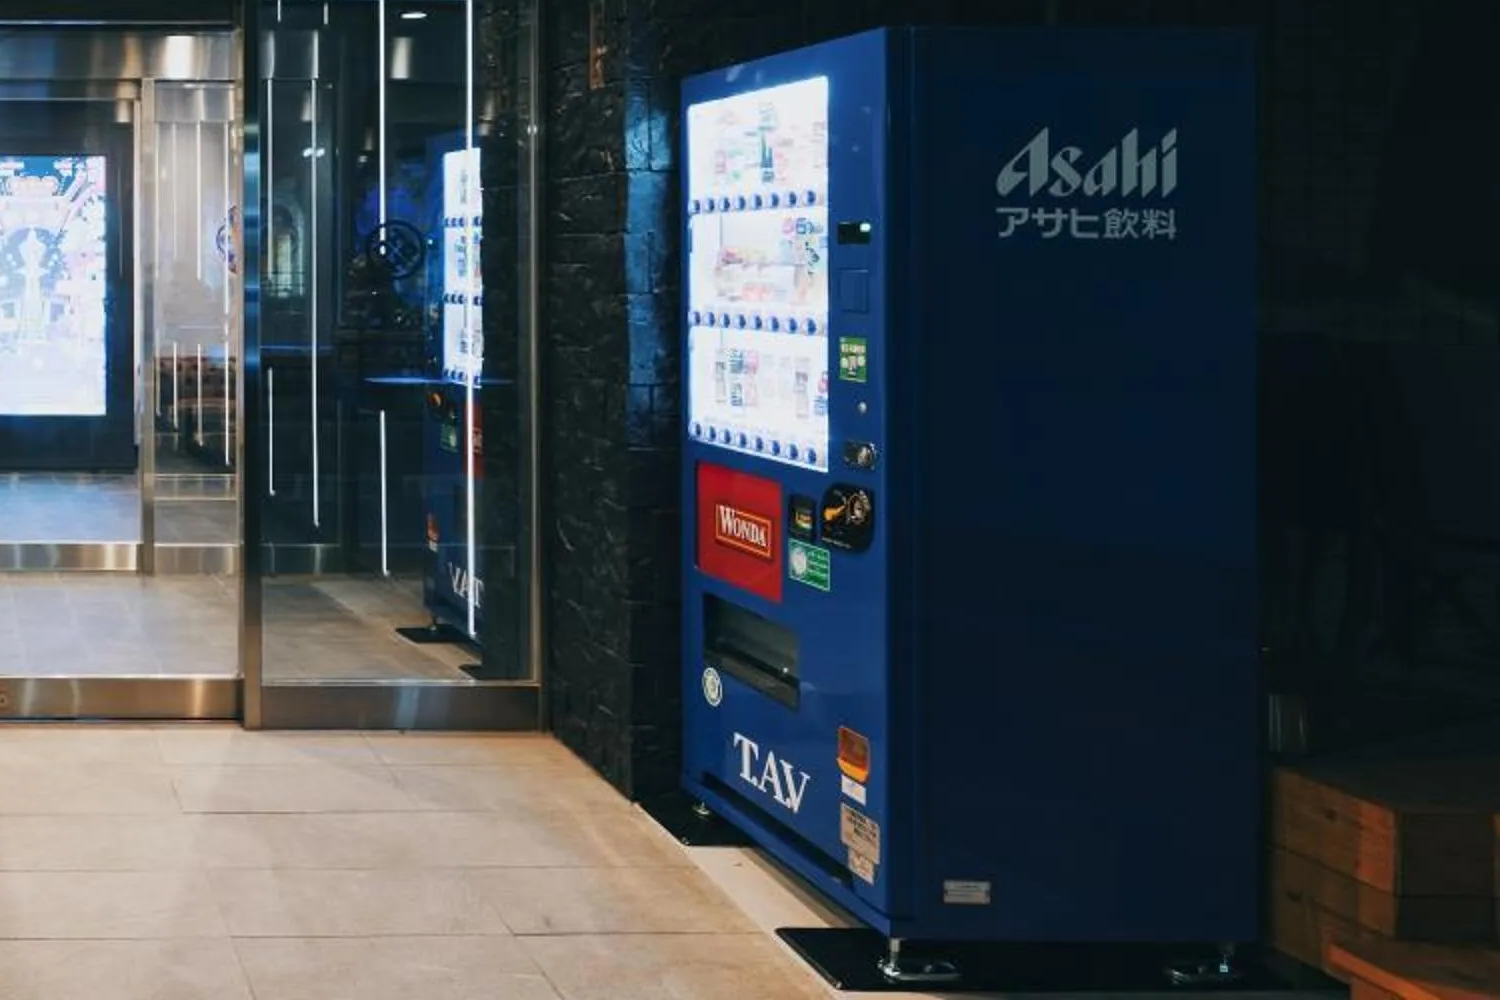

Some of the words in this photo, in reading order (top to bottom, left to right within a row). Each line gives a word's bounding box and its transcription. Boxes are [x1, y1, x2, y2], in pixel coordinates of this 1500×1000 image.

[995, 126, 1179, 199] Asahi
[995, 206, 1178, 241] アサヒ飲料
[718, 504, 768, 548] WONDA
